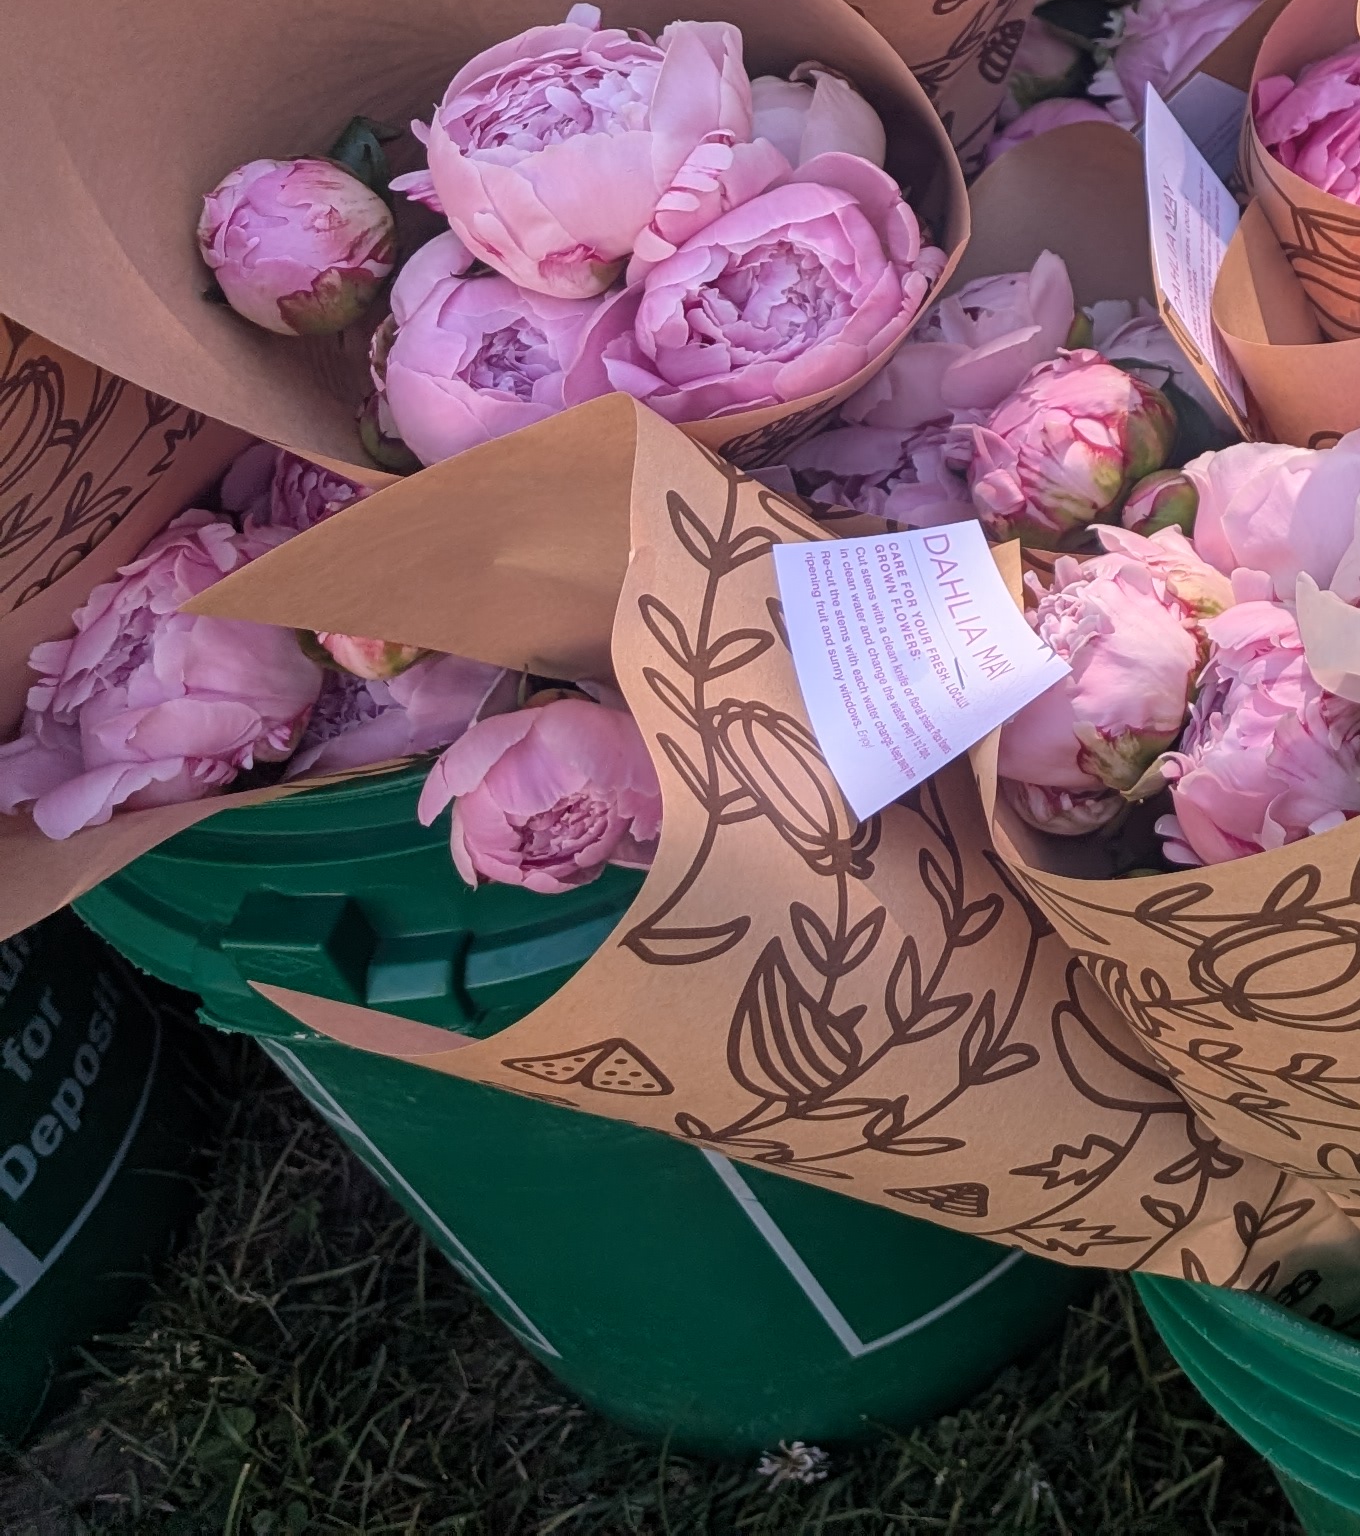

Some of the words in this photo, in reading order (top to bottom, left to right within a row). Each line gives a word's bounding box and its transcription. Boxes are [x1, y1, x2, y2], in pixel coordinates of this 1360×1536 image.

[1163, 173, 1174, 230] MAY
[1166, 231, 1185, 321] DAHLIA
[820, 550, 837, 587] Re-cut
[855, 546, 868, 567] Cut
[805, 552, 822, 598] ripening
[842, 561, 857, 592] clean
[861, 569, 877, 601] stems
[829, 588, 841, 607] the
[851, 592, 867, 623] water
[874, 544, 898, 594] GROWN
[891, 598, 921, 662] FLOWERS:
[923, 534, 987, 646] DAHLIA
[972, 645, 1016, 681] MAY
[816, 600, 830, 623] fruit
[871, 602, 886, 625] with
[821, 624, 836, 647] and
[834, 609, 851, 643] stems
[860, 624, 877, 646] and
[878, 626, 888, 634] a
[888, 542, 908, 578] CARE
[901, 582, 918, 607] FOR
[912, 611, 932, 644] YOUR
[927, 647, 951, 684] FRESH,
[945, 683, 970, 709] LOCALLY
[845, 643, 860, 668] with
[881, 635, 899, 664] clean
[827, 648, 845, 682] sunny
[867, 647, 888, 685] change
[892, 664, 909, 688] knife
[853, 668, 869, 694] each
[882, 685, 896, 701] the
[903, 687, 915, 697] or
[839, 683, 862, 730] windows.
[862, 695, 880, 720] water
[890, 701, 907, 722] water
[908, 696, 926, 716] floral
[857, 729, 875, 749] Enjoy!
[901, 721, 917, 739] every
[889, 745, 904, 761] Keep
[2, 983, 63, 1083] for
